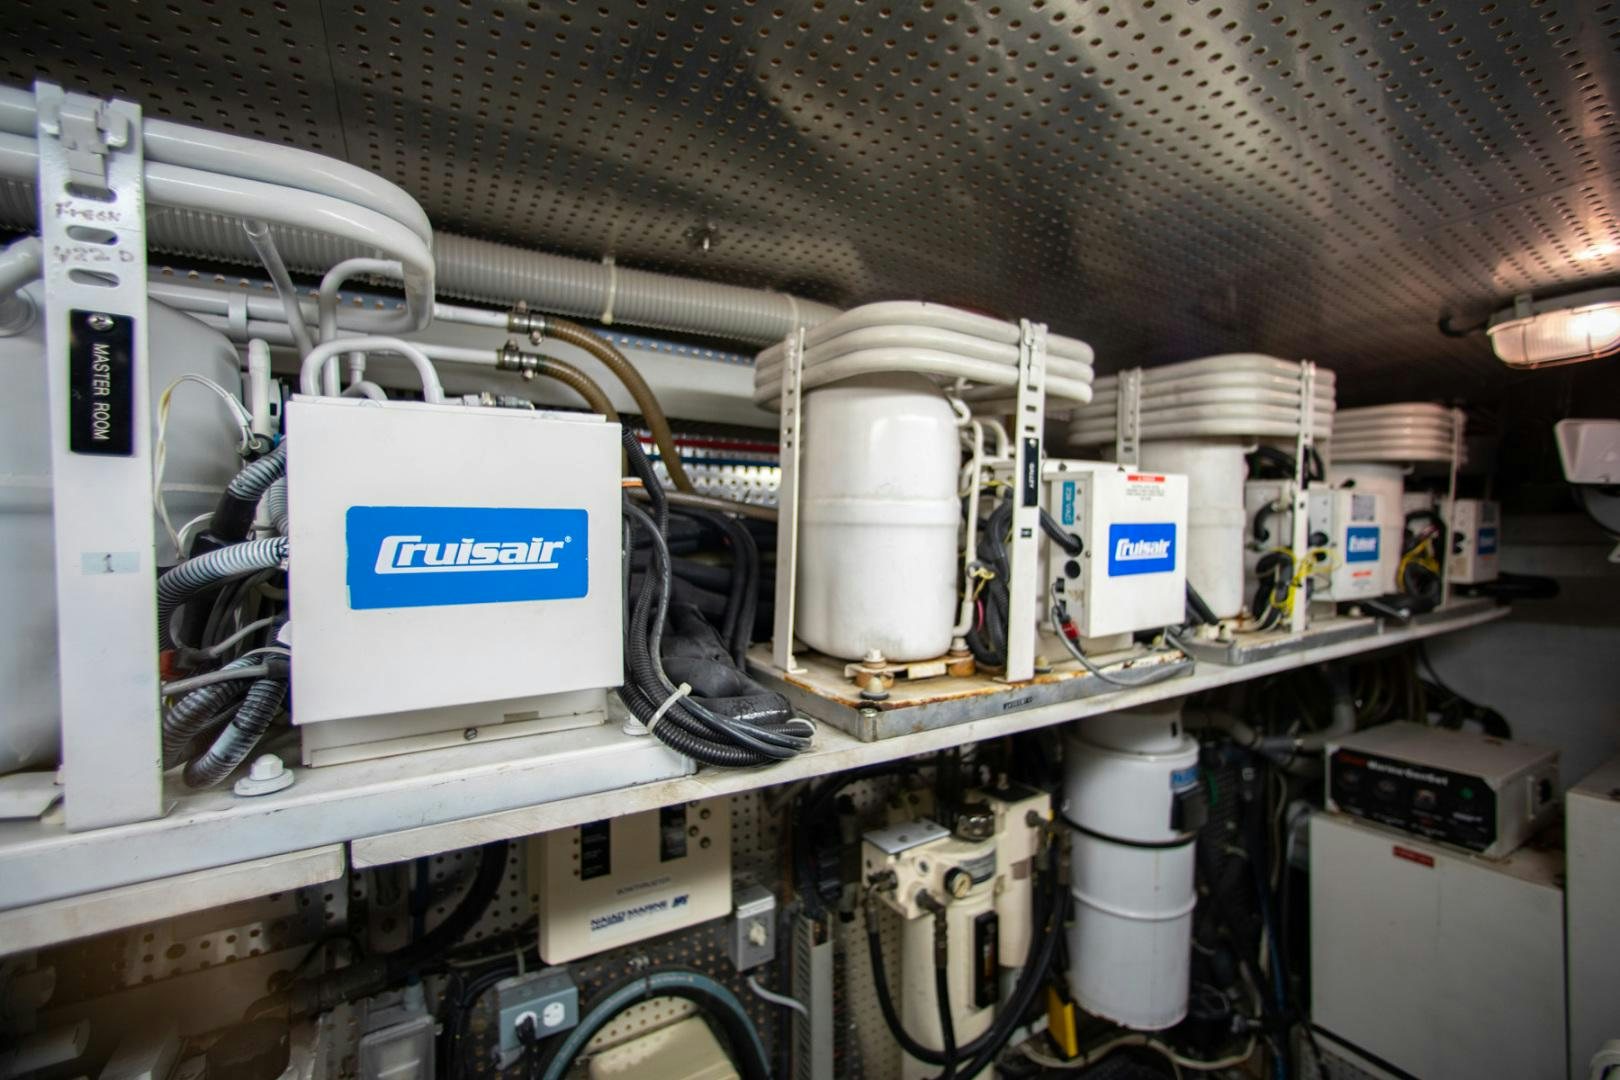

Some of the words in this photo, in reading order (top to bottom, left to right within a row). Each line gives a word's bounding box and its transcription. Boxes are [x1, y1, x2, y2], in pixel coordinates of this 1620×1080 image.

[92, 343, 111, 396] MASTER
[92, 402, 111, 440] ROOM
[1115, 538, 1171, 561] Cruisair
